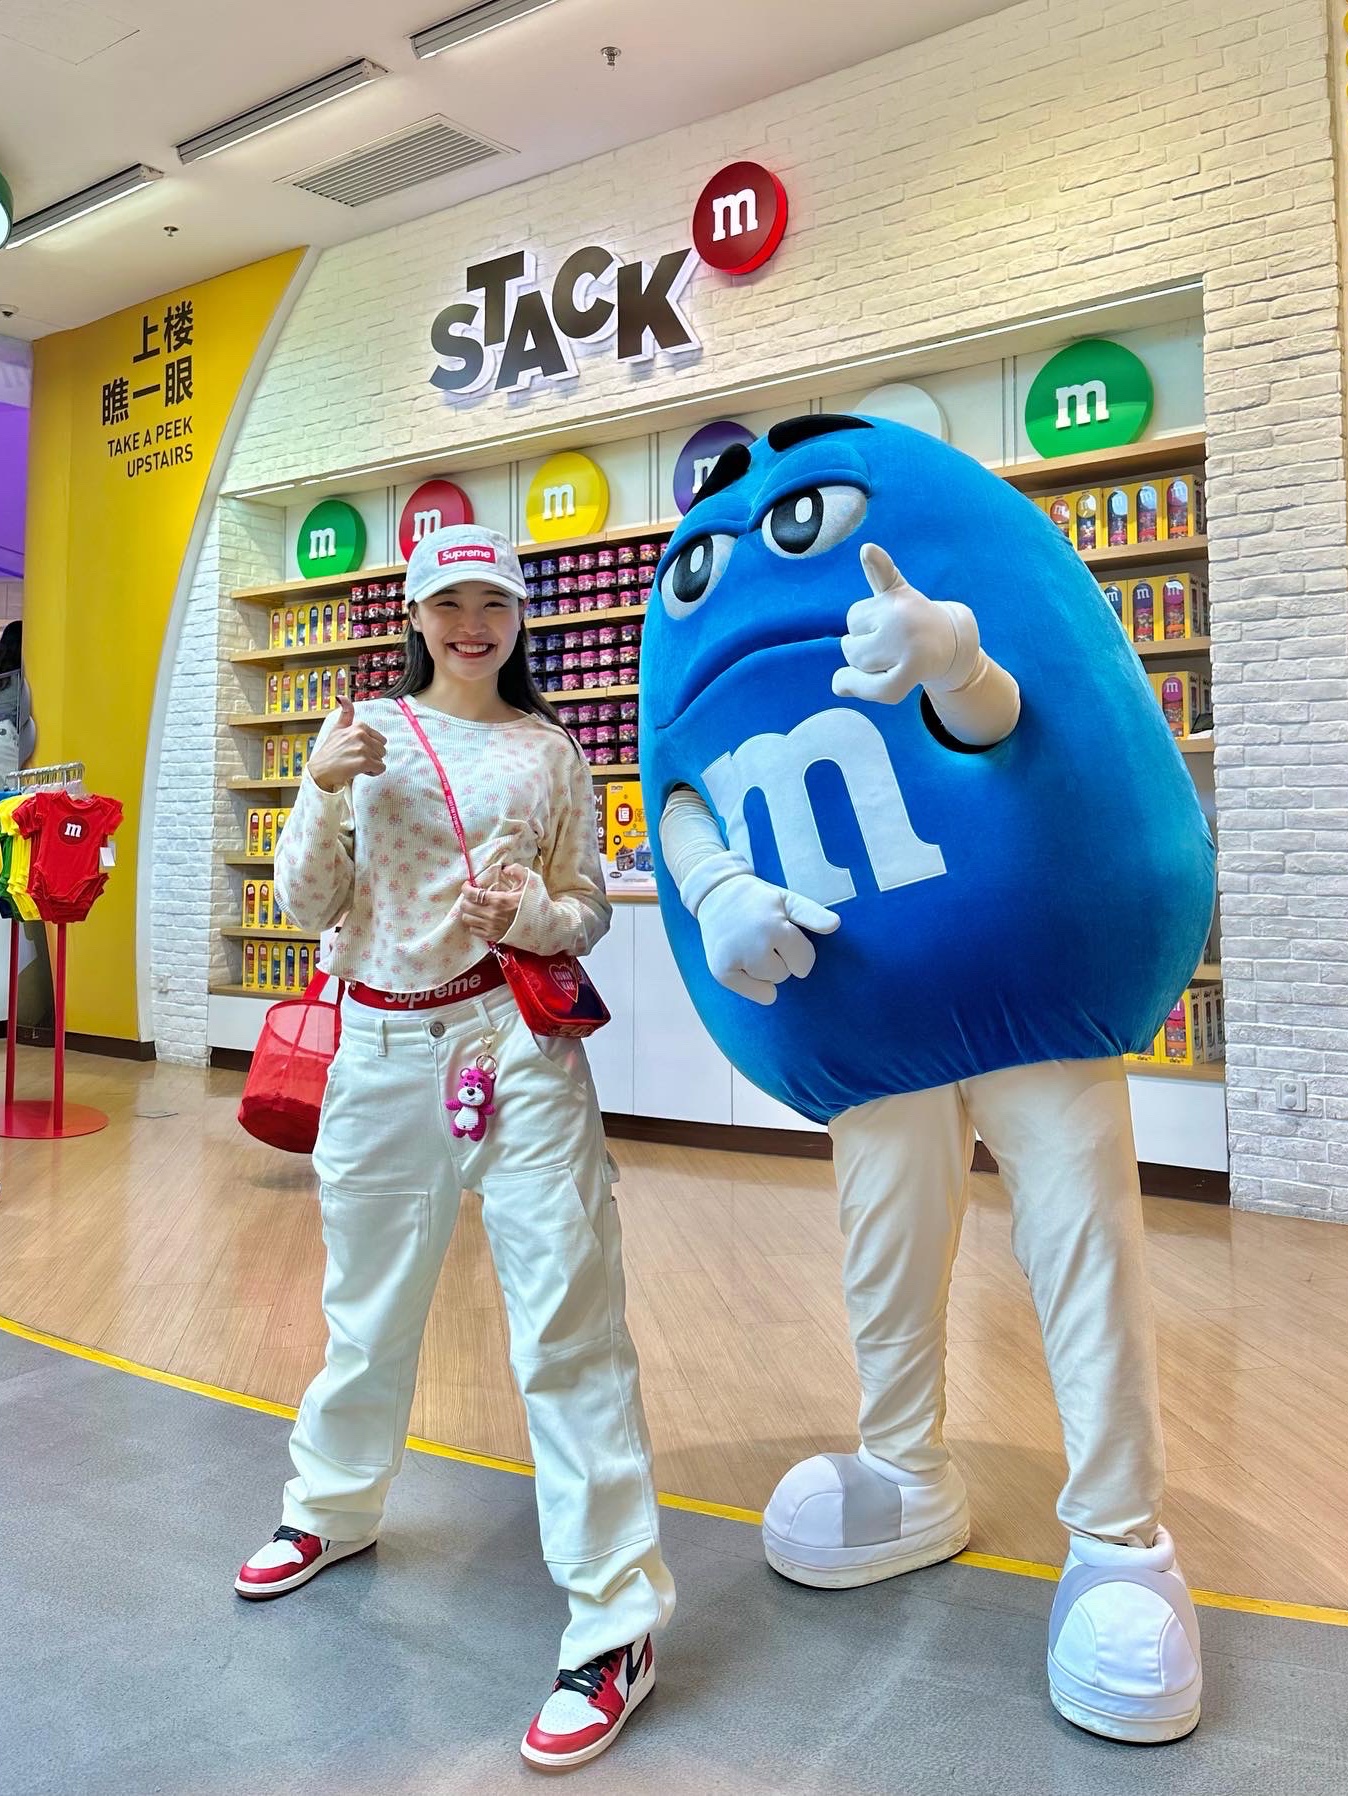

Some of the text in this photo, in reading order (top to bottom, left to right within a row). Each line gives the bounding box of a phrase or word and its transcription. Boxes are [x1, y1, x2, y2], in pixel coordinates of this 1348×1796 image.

[712, 188, 759, 242] m
[132, 300, 194, 364] 上楼
[428, 245, 693, 391] STACK
[102, 355, 194, 426] 瞧一眼
[1055, 380, 1110, 429] m
[107, 415, 194, 458] TAKE A PEEK
[127, 443, 194, 478] UPSTAIRS
[542, 483, 576, 521] m
[308, 527, 337, 560] m
[412, 508, 442, 542] m
[441, 549, 492, 561] Supreme
[1136, 588, 1150, 600] m
[1165, 681, 1179, 693] m
[701, 708, 947, 907] m
[64, 822, 82, 838] m
